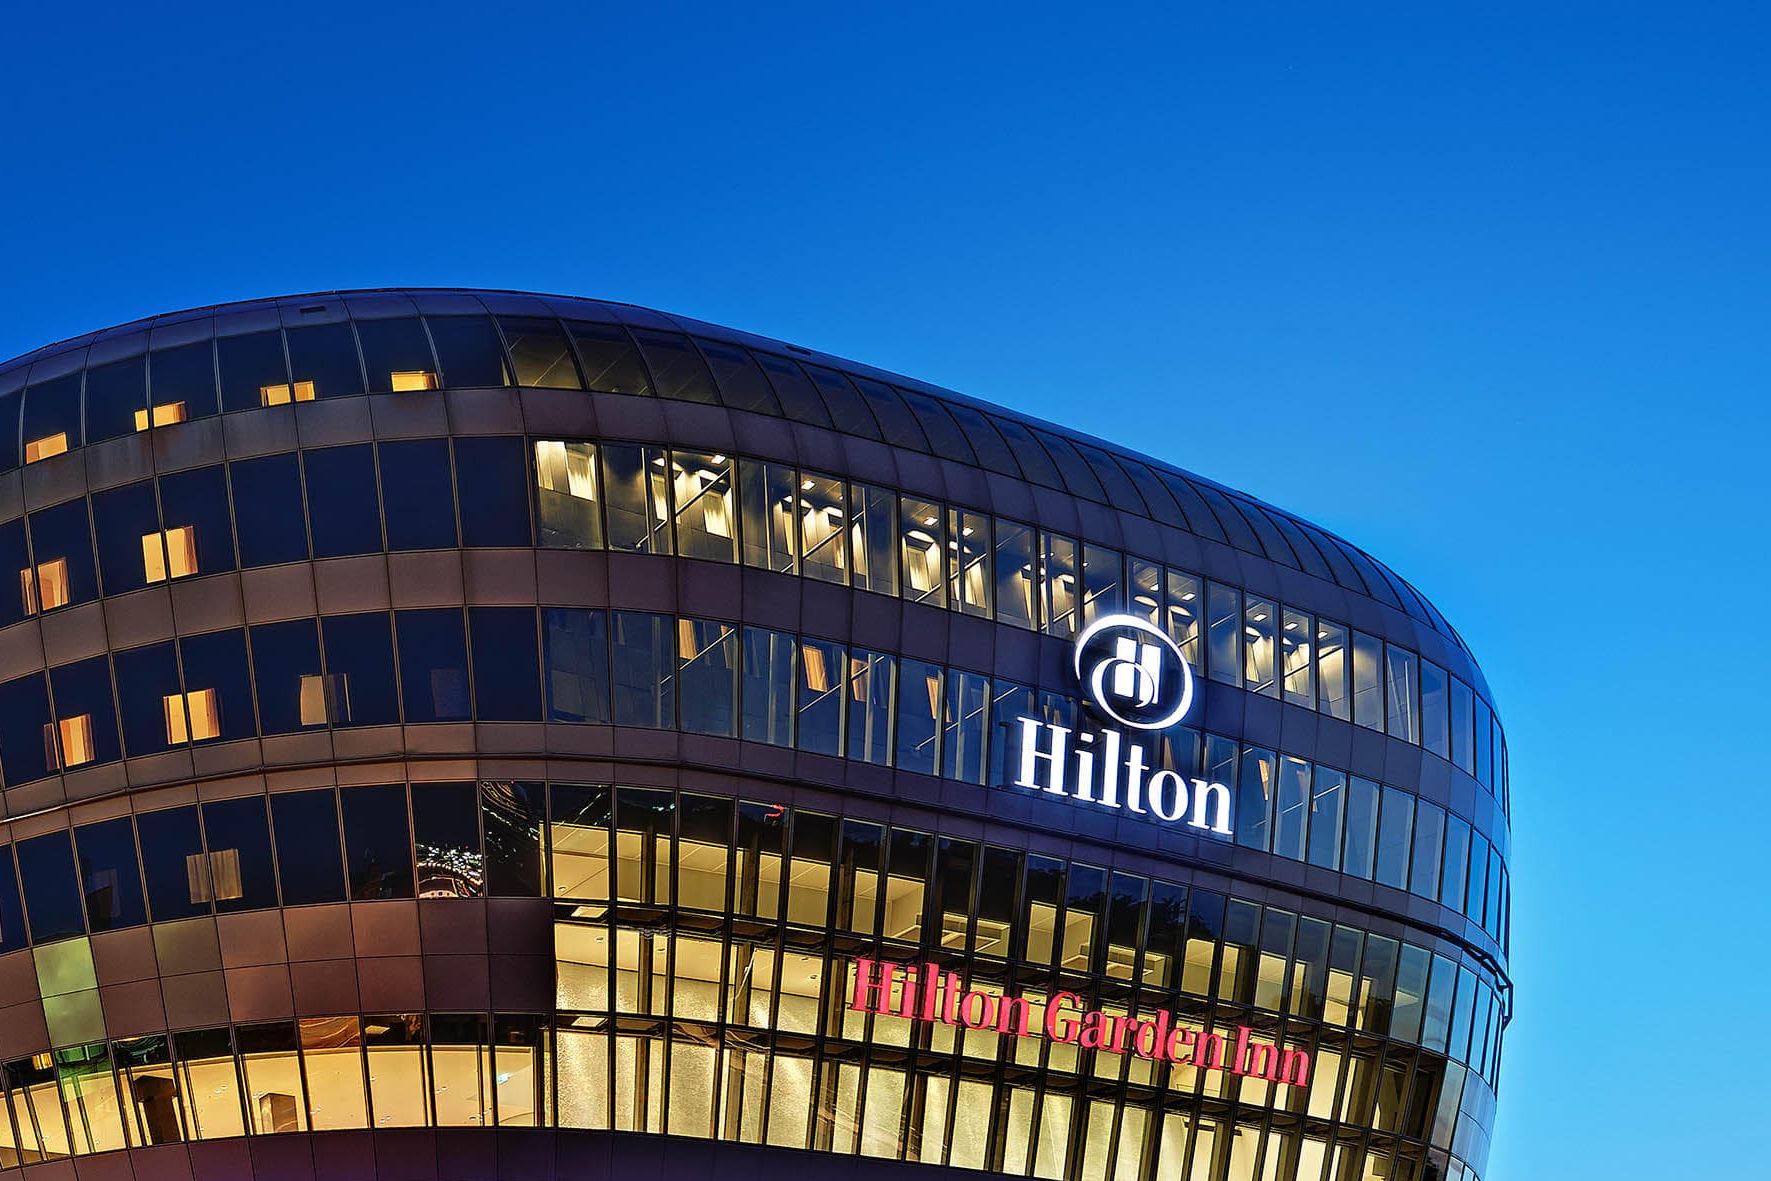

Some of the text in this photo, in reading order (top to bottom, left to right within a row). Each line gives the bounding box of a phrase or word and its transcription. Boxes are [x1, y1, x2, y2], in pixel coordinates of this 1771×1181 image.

[1014, 716, 1233, 835] Hilton
[850, 957, 1310, 1088] Hilton Garden Inn
